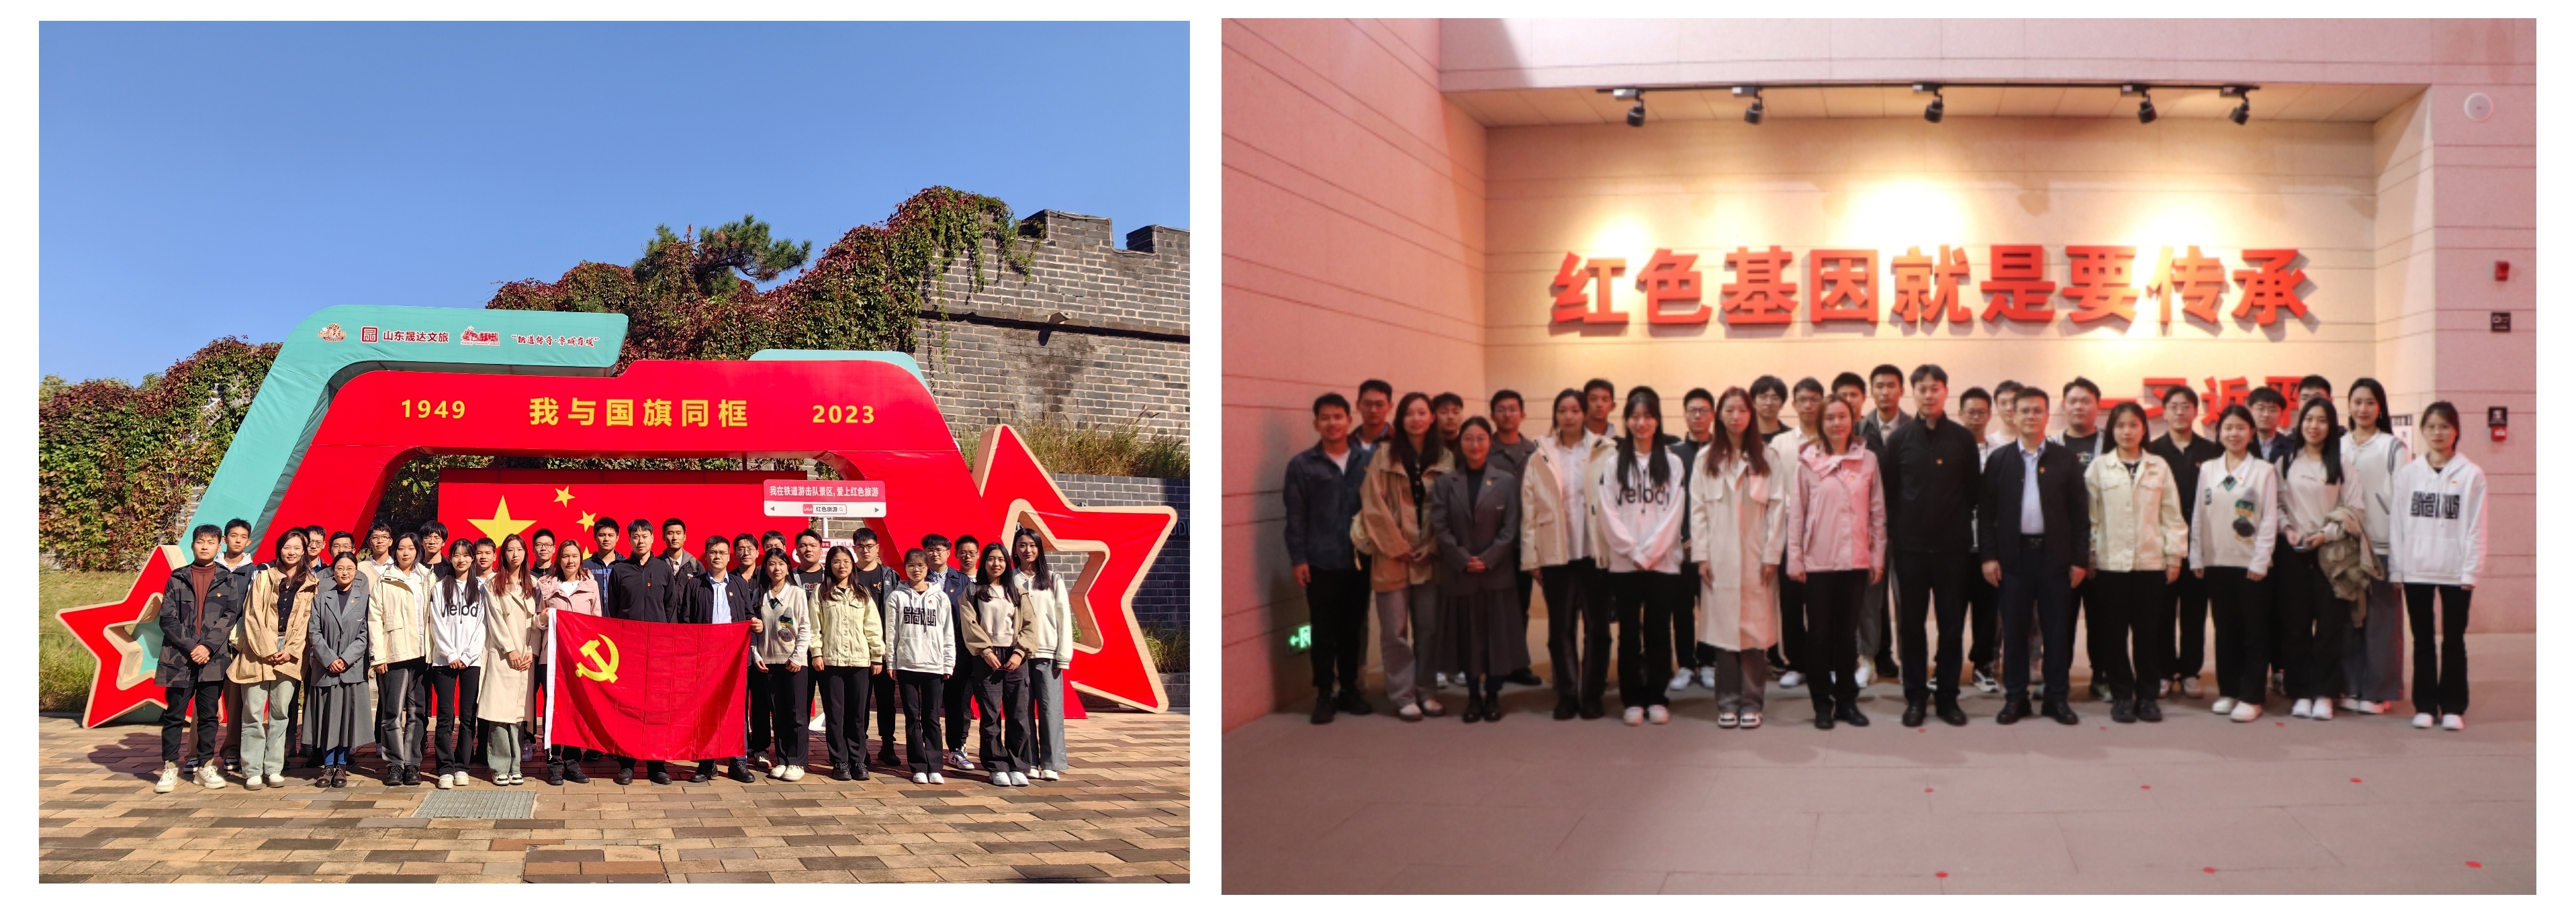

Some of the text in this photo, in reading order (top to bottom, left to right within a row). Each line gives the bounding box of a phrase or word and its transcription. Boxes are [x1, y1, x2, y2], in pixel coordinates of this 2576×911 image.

[1553, 244, 2308, 326] 红色基因就是要传承
[383, 330, 449, 342] 山东晟达文旅
[402, 399, 465, 419] 1949
[529, 397, 747, 427] 我与国旗同框
[813, 405, 874, 424] 2023
